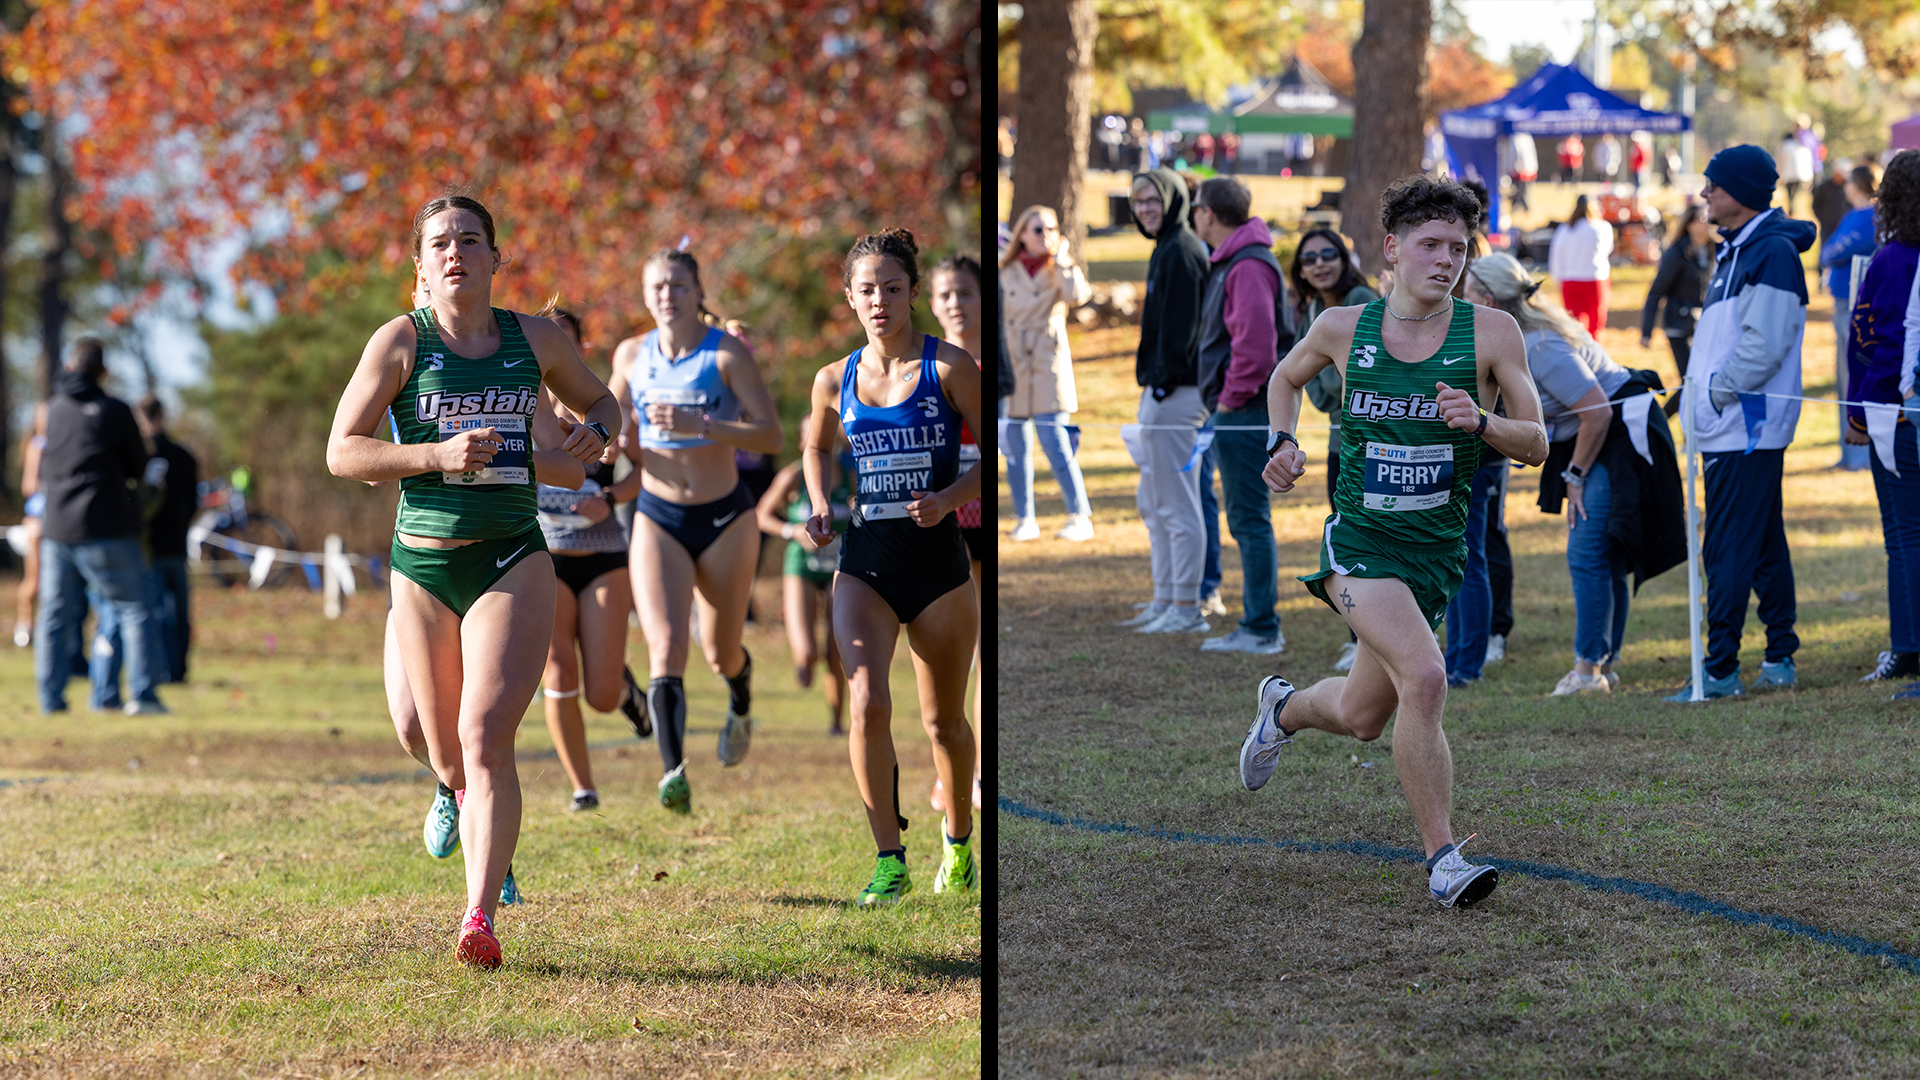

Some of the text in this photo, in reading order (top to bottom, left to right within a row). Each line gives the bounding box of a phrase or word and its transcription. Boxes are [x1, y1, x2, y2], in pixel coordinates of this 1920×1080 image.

[415, 386, 538, 424] Upstate
[1349, 389, 1444, 423] Upsta
[446, 420, 482, 430] SOUTH
[484, 438, 525, 452] EYER
[1373, 447, 1407, 459] SOUTH
[890, 460, 925, 468] CHAMPIONSHIPS
[1377, 463, 1441, 485] PERRY
[860, 471, 930, 494] MURPHY
[1401, 485, 1415, 493] 182
[886, 492, 900, 500] 119
